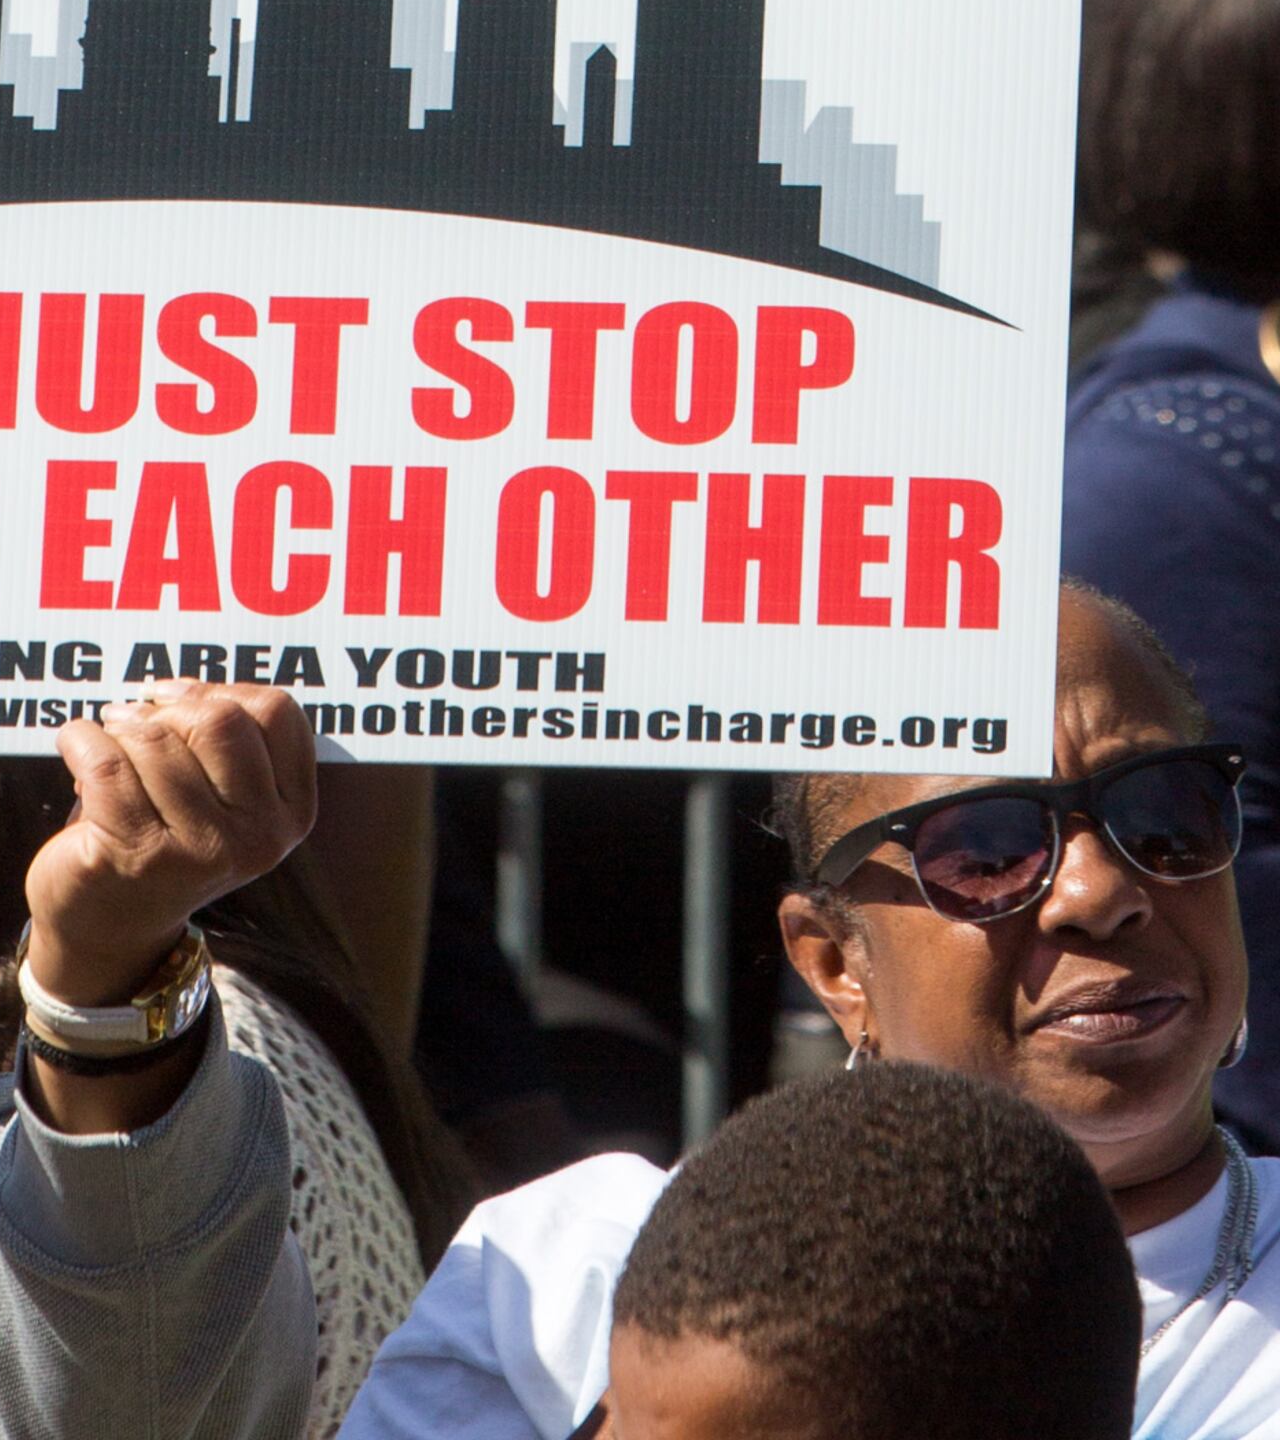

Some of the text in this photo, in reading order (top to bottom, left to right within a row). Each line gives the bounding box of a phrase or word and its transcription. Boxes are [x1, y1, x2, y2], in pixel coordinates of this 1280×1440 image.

[411, 296, 855, 446] STOP
[39, 459, 448, 617] EACH
[495, 465, 1004, 630] OTHER
[122, 642, 330, 688] AREA
[345, 647, 607, 693] YOUTH
[125, 697, 1008, 755] mothersincharge.org
